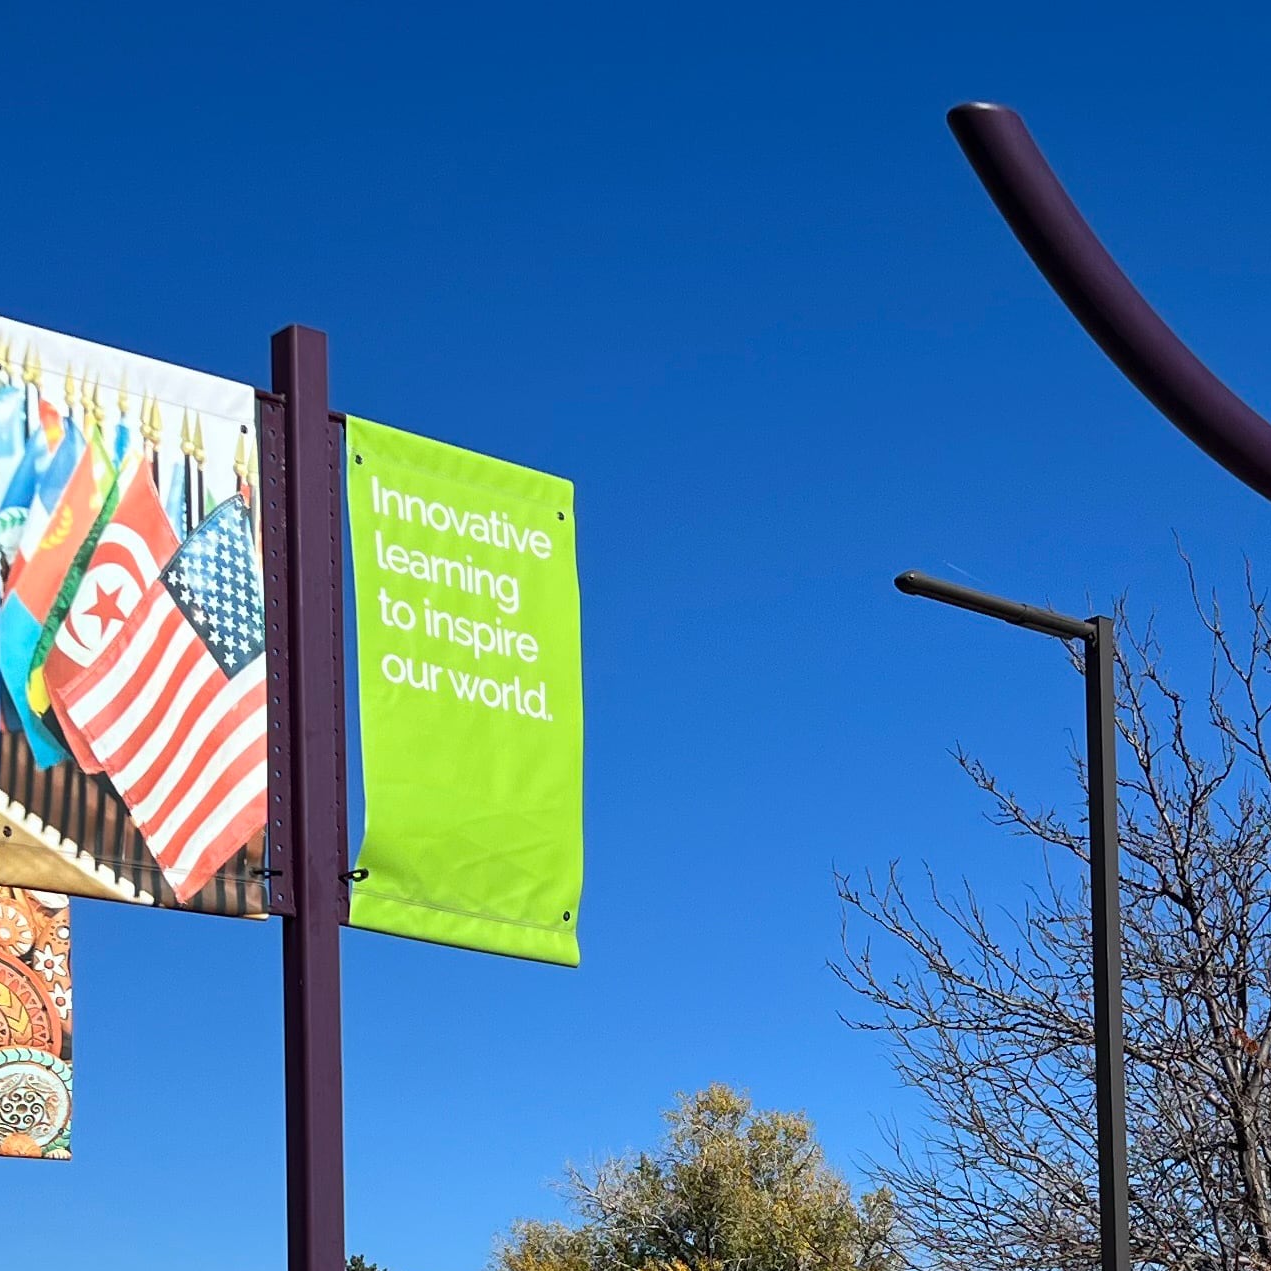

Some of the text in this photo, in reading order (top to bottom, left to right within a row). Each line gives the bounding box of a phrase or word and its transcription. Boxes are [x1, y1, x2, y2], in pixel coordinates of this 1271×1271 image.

[371, 475, 552, 559] Innovative
[375, 530, 519, 614] learning
[378, 587, 539, 662] to inspire
[381, 654, 553, 721] our world.
